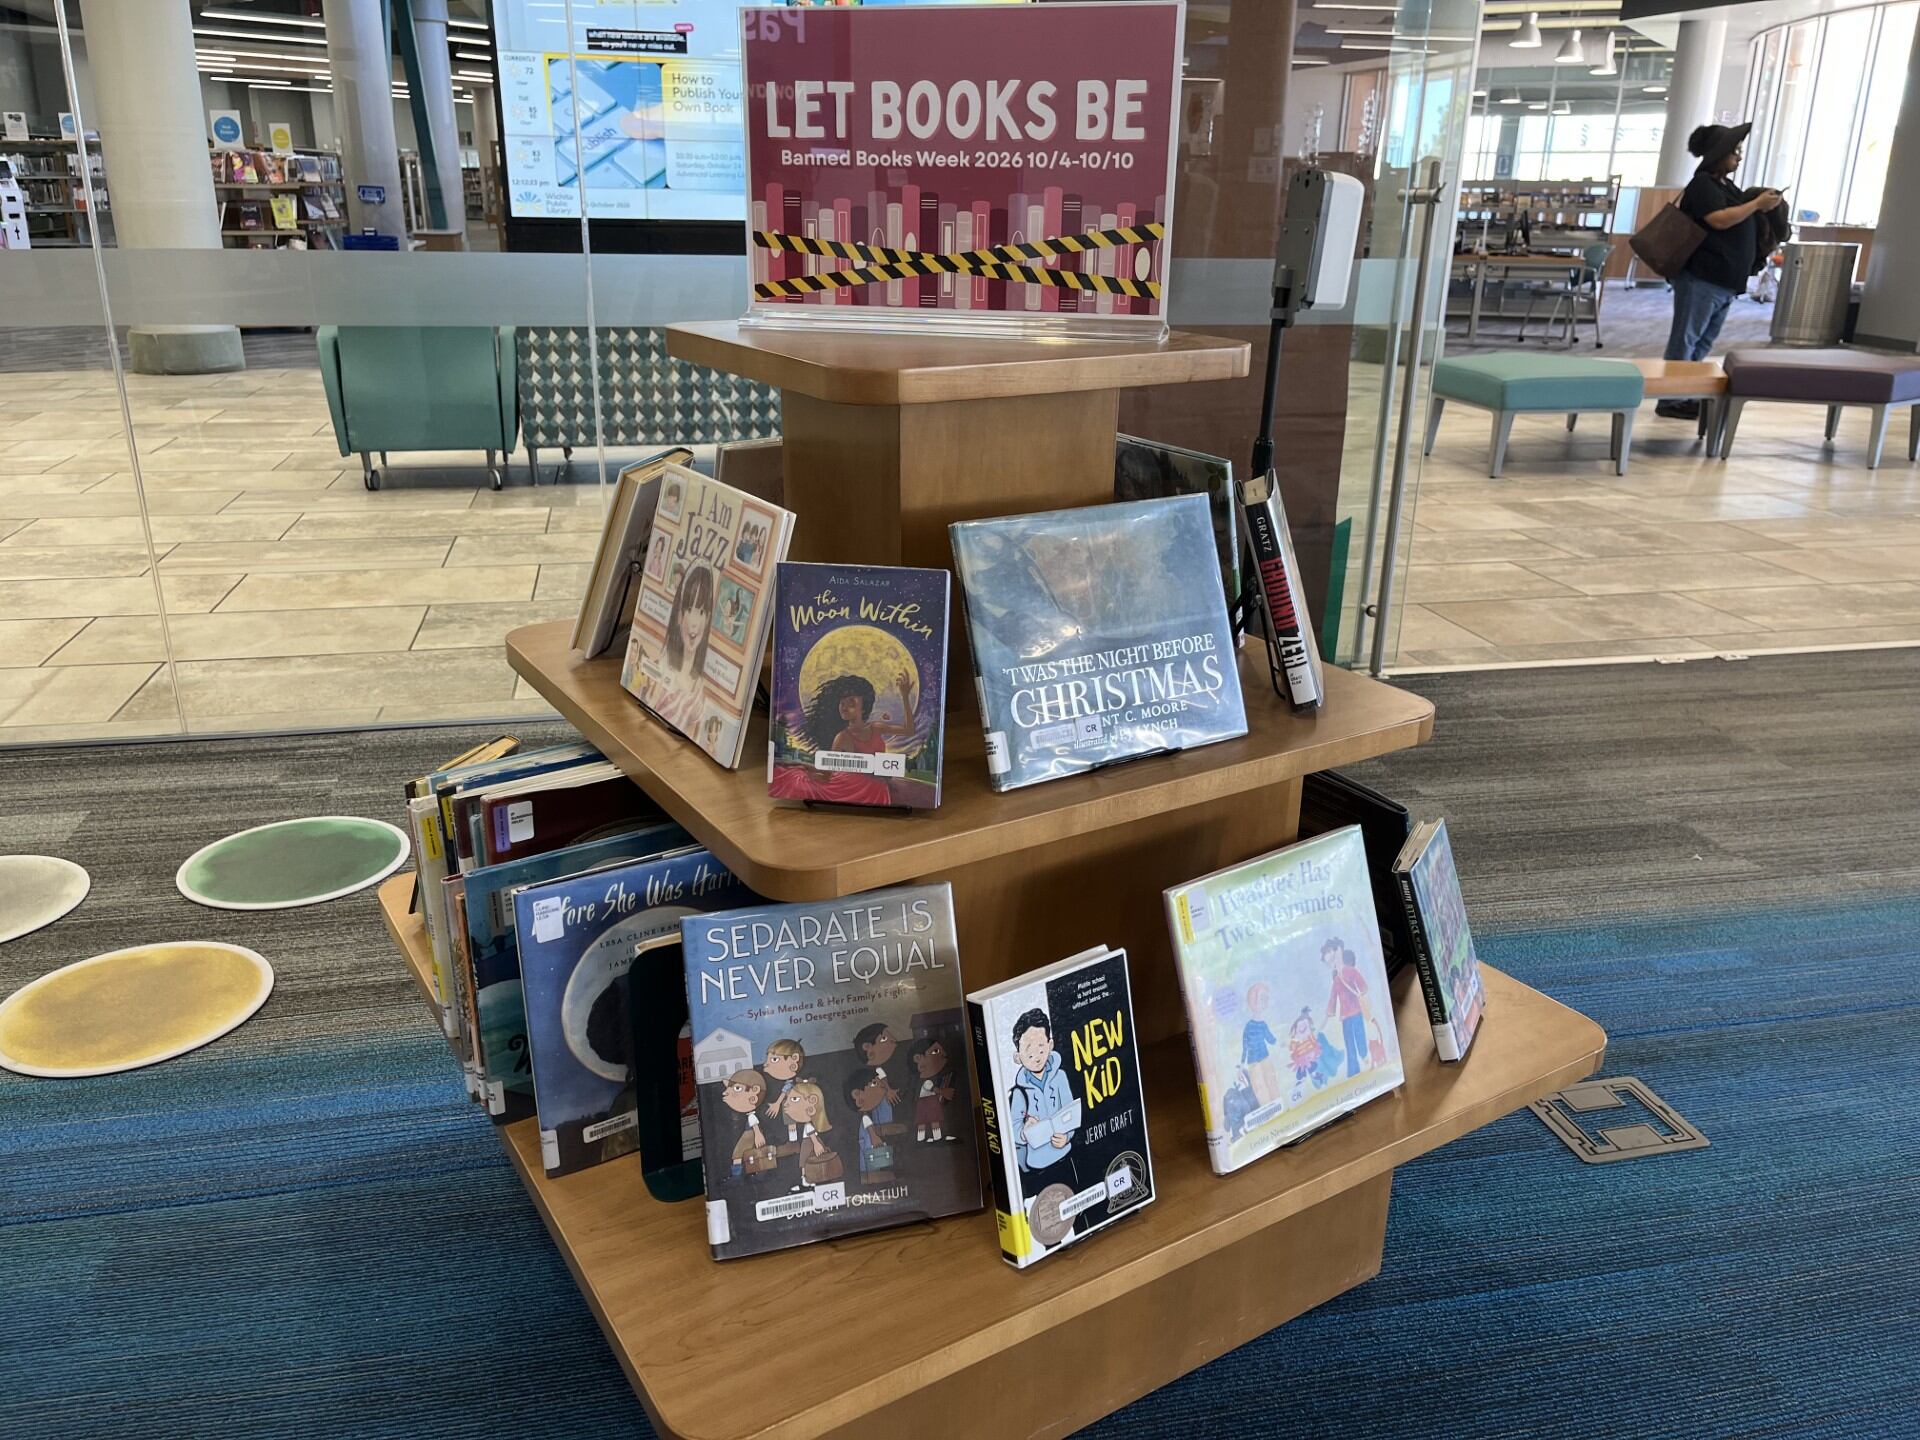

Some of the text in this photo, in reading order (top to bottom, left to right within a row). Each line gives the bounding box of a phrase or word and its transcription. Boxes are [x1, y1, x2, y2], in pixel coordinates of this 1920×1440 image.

[672, 73, 714, 85] How to
[673, 87, 716, 99] Publish
[719, 89, 742, 100] You
[673, 101, 734, 113] Own Book
[766, 79, 1148, 141] LET BOOKS BE
[583, 127, 617, 151] ublish
[781, 149, 1134, 170] Banned Books Week 2026 10/4-10/10
[708, 500, 733, 531] Am
[675, 512, 730, 571] Jazz
[1256, 516, 1273, 552] GRATZ
[829, 575, 891, 588] AIDA SALAZAR
[1260, 556, 1298, 630] GROUND
[813, 590, 838, 606] the
[790, 597, 934, 640] Moon Within
[1062, 655, 1096, 676] THE
[1097, 645, 1151, 671] NIGHT
[1152, 633, 1216, 661] BEFORE
[1010, 655, 1224, 729] CHRISTMAS
[1125, 710, 1137, 721] C.
[1141, 701, 1188, 720] MOORE
[1085, 723, 1098, 733] CR
[882, 760, 899, 770] CR
[561, 896, 595, 926] fore
[601, 882, 636, 921] She
[646, 870, 683, 906] Was
[1218, 860, 1331, 916] Heather Has
[707, 899, 933, 963] SEPARATE IS
[1215, 920, 1256, 950] Two
[1262, 890, 1344, 929] Mommies
[600, 937, 623, 949] LESA
[1405, 903, 1418, 934] ATTACK
[1418, 953, 1431, 986] MUTANT
[700, 937, 944, 1005] NEVER EQUAL
[747, 987, 907, 1020] Sylvia Mendez & Her Family's Fight
[789, 1006, 869, 1024] for Desegregation
[1070, 1010, 1123, 1072] NEW
[982, 1097, 997, 1130] NEW
[1291, 1093, 1302, 1102] CR
[1085, 1109, 1133, 1145] JERRY CRAFT
[822, 1189, 839, 1201] CR
[845, 1185, 909, 1208] TONATIUH
[1113, 1176, 1126, 1188] CR
